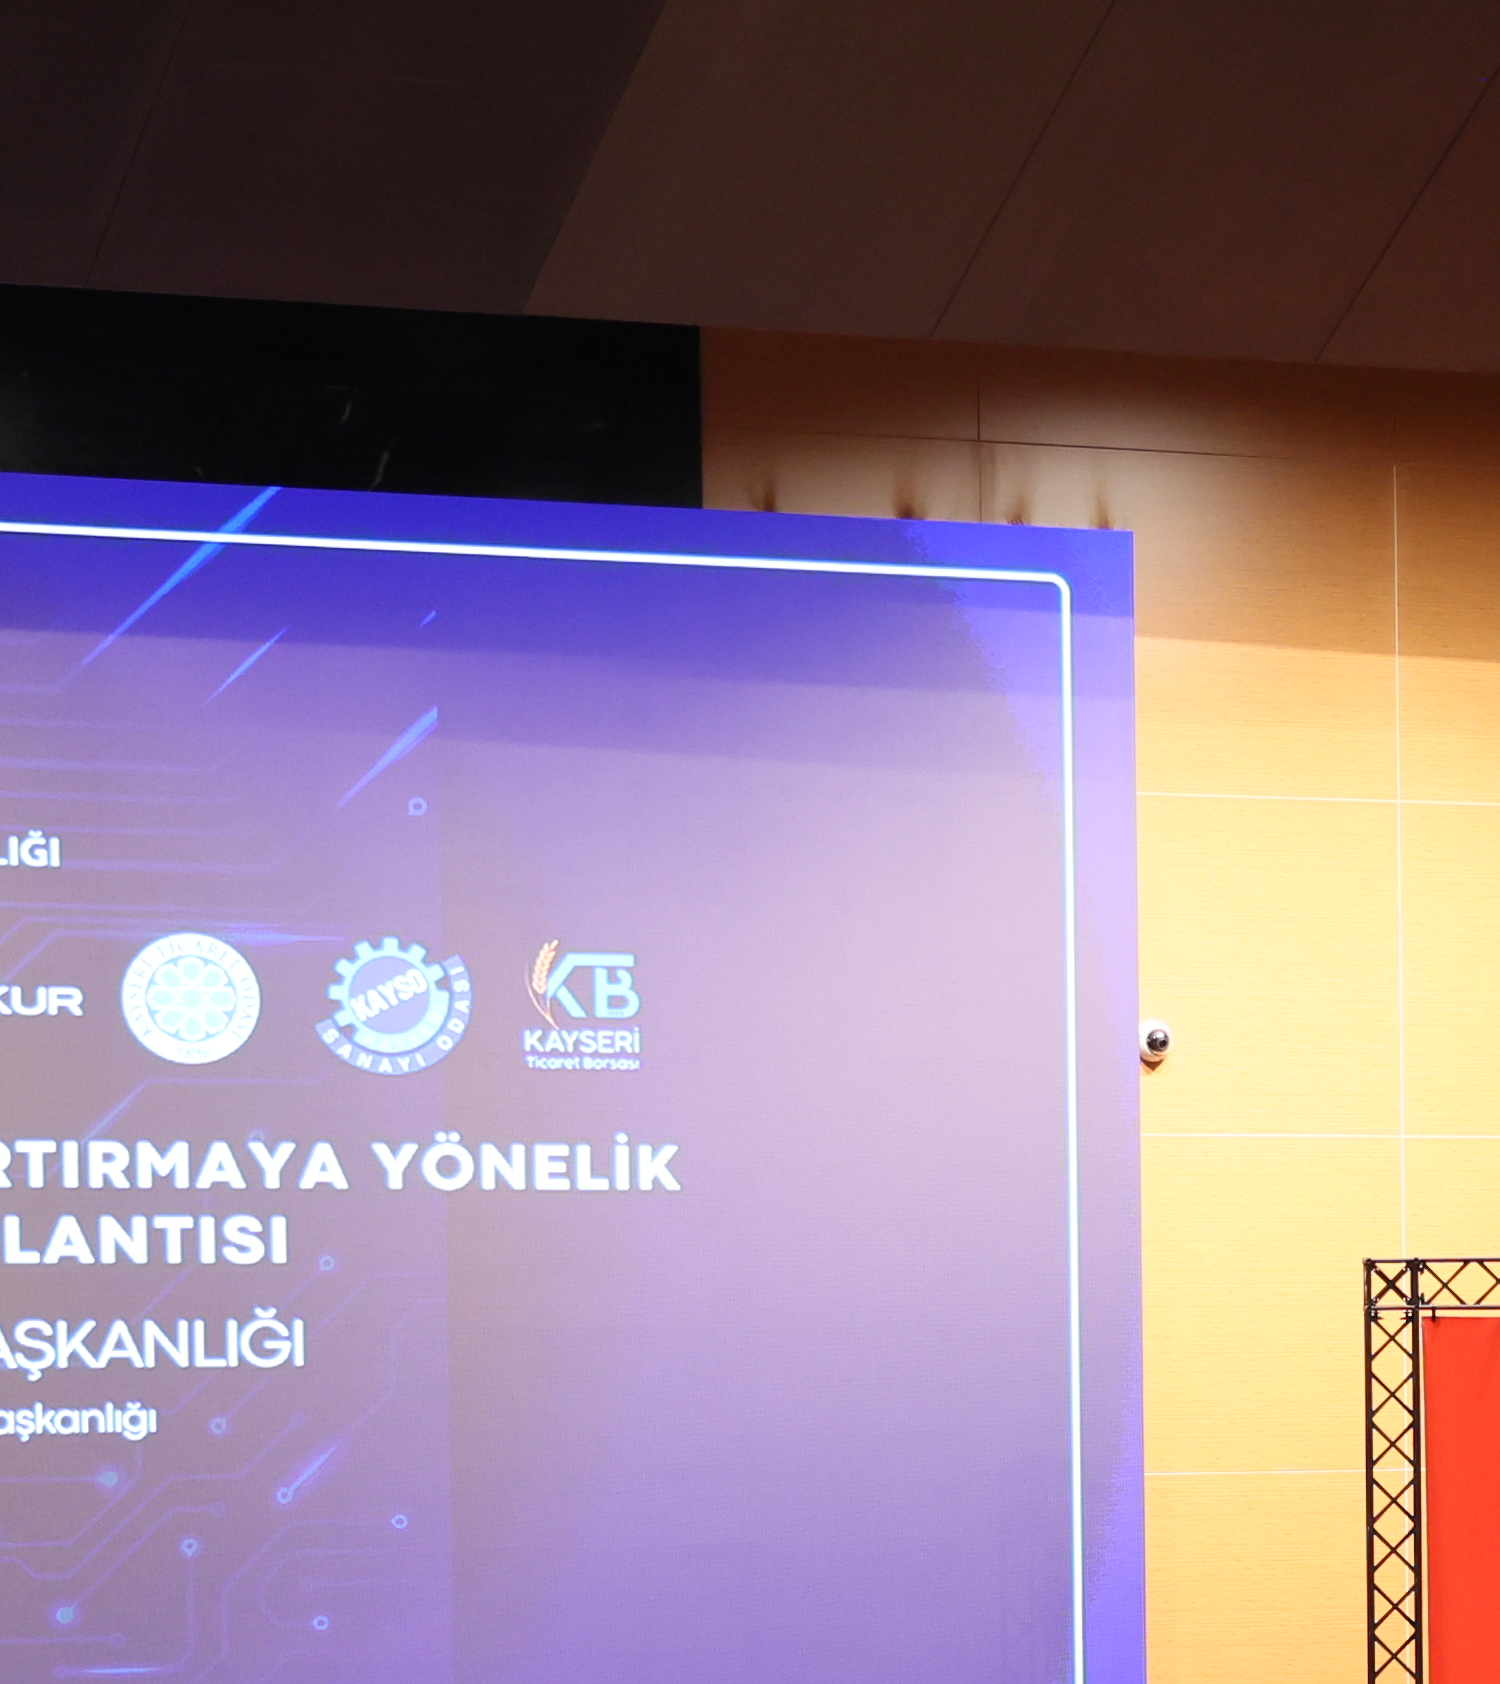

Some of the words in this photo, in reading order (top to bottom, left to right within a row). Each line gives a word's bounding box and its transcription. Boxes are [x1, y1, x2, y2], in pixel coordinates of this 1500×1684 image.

[350, 968, 429, 1022] KAYSO
[524, 1026, 640, 1054] KAYSERİ
[372, 1132, 681, 1191] YÖNELİK
